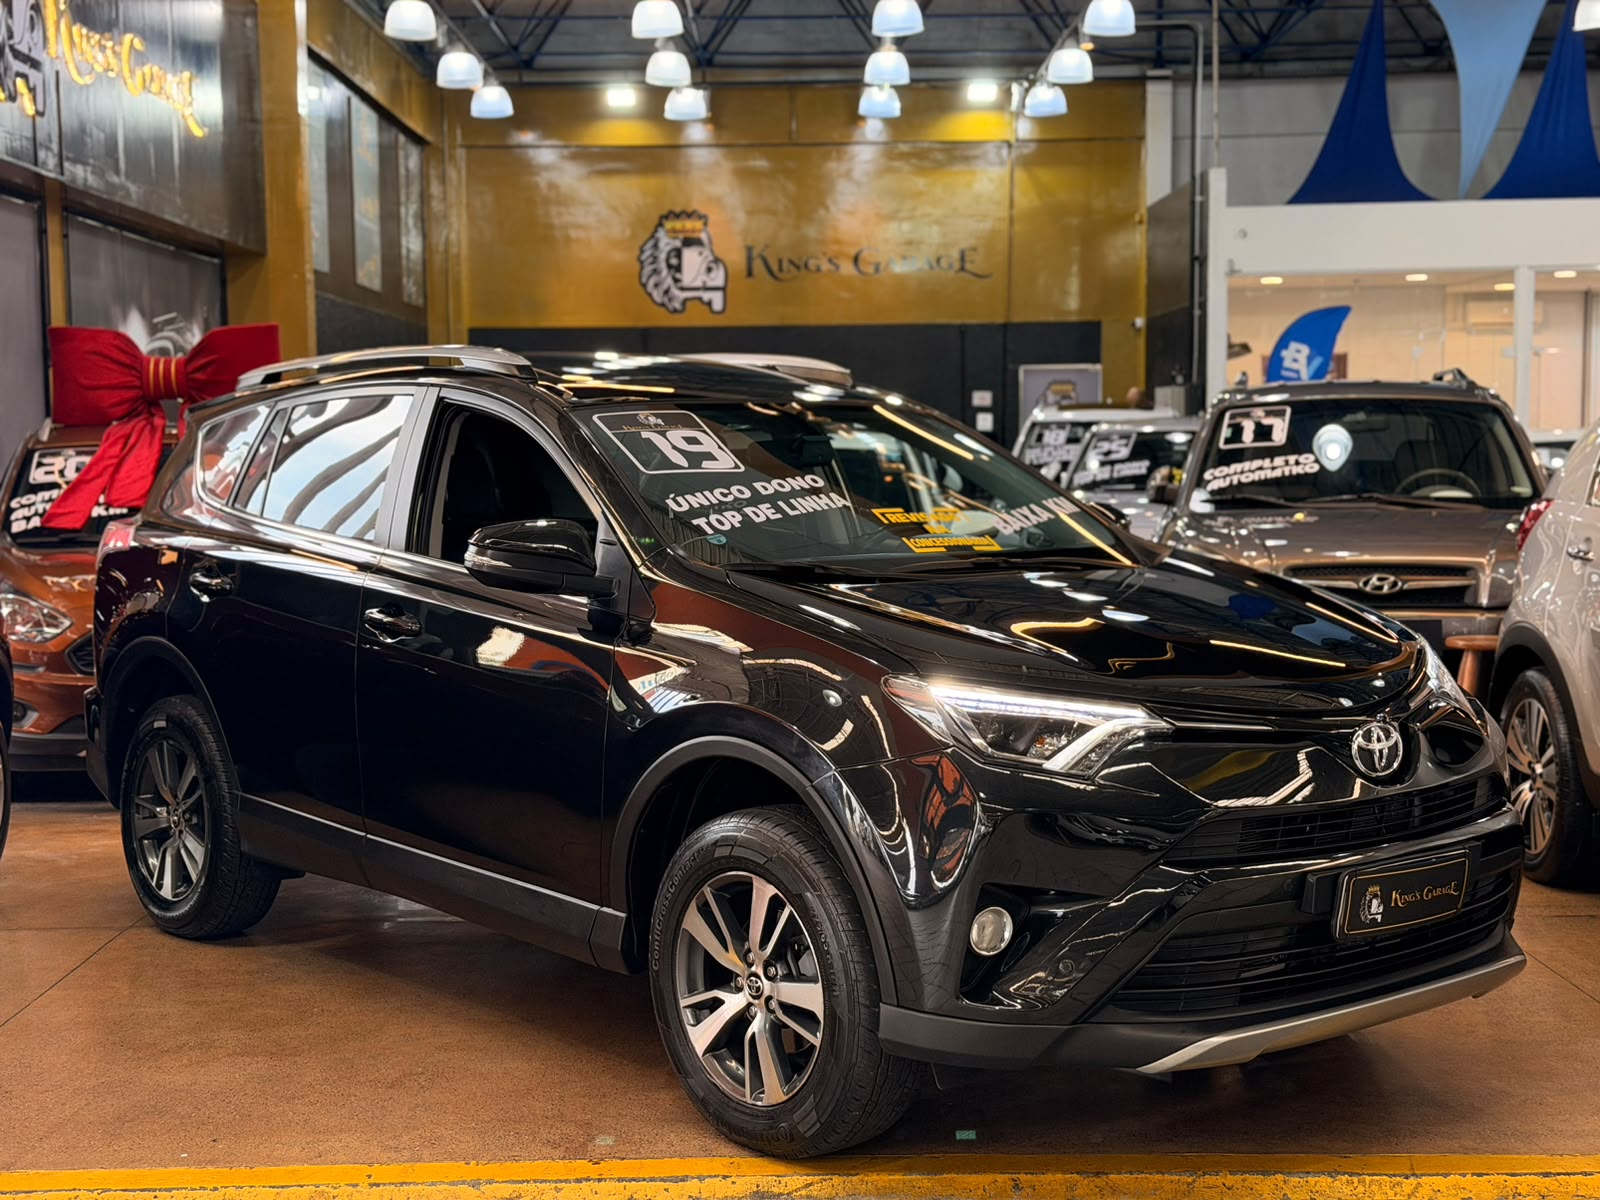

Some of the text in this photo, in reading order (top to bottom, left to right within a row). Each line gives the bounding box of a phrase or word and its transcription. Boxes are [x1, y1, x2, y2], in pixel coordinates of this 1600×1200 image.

[641, 430, 735, 469] 19
[1203, 453, 1315, 480] COMPLETO
[665, 474, 825, 512] ÚNICO DONO
[692, 492, 851, 534] TOP DE LINHA
[993, 496, 1081, 535] BAIXA KM
